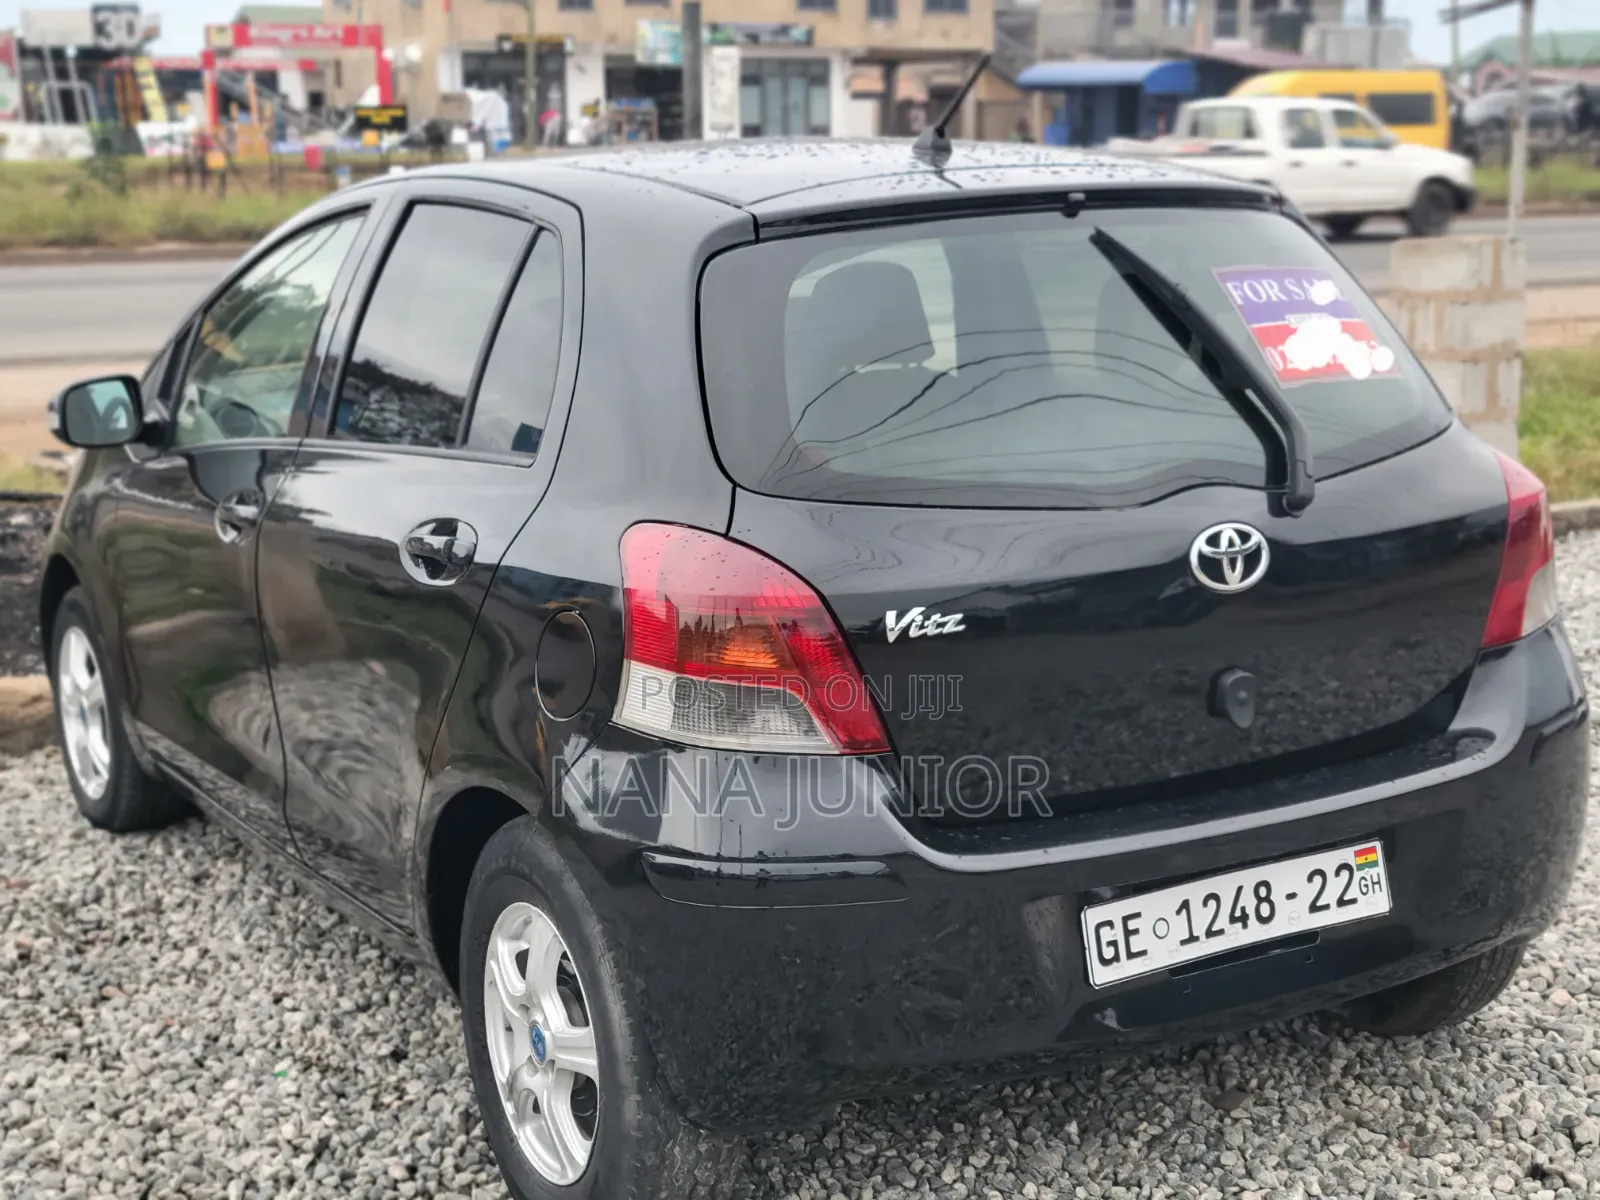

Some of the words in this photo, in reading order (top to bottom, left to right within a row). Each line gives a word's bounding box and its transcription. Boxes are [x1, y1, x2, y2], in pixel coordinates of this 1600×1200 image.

[1225, 278, 1288, 305] FOR
[885, 606, 967, 643] Vitz
[1358, 873, 1382, 896] GH
[1094, 912, 1148, 967] GE
